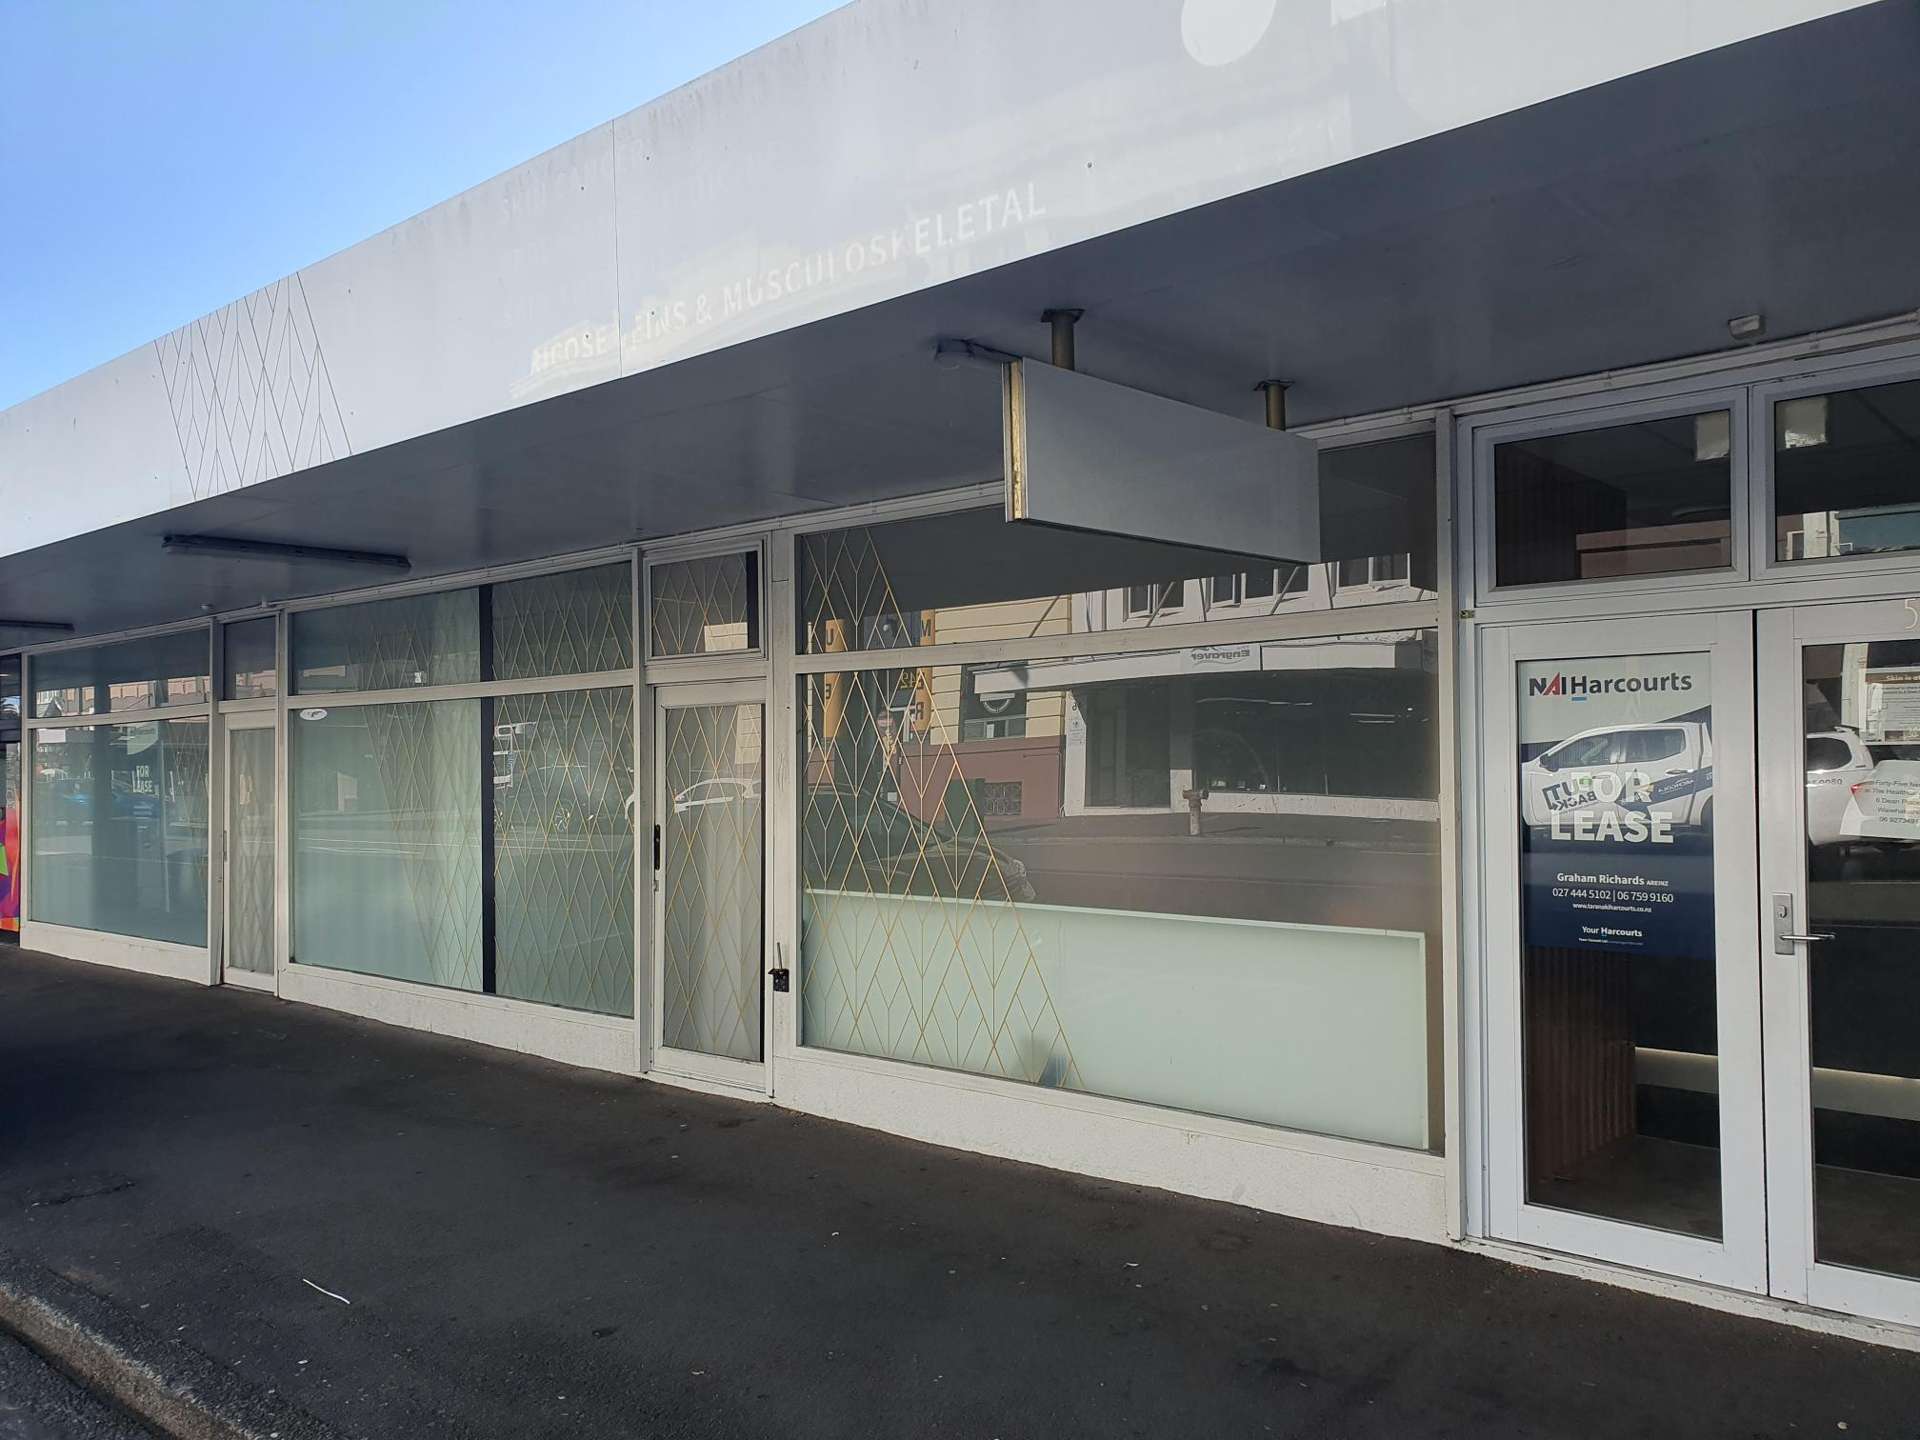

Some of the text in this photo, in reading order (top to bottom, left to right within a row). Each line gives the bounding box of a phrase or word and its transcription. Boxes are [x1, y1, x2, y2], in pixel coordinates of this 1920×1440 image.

[696, 293, 713, 325] &
[1529, 671, 1692, 697] NAI Harcourts
[136, 765, 149, 778] FOR
[1570, 770, 1653, 803] FOR
[1551, 810, 1674, 844] LEASE
[1556, 872, 1597, 884] Graham
[1599, 873, 1645, 886] Richards
[1552, 887, 1569, 897] 027
[1570, 888, 1588, 899] 444
[1588, 889, 1611, 900] 5102
[1617, 890, 1630, 901] 06
[1631, 891, 1649, 902] 759
[1650, 892, 1674, 903] 9160
[1582, 926, 1643, 938] Your Harcourts
